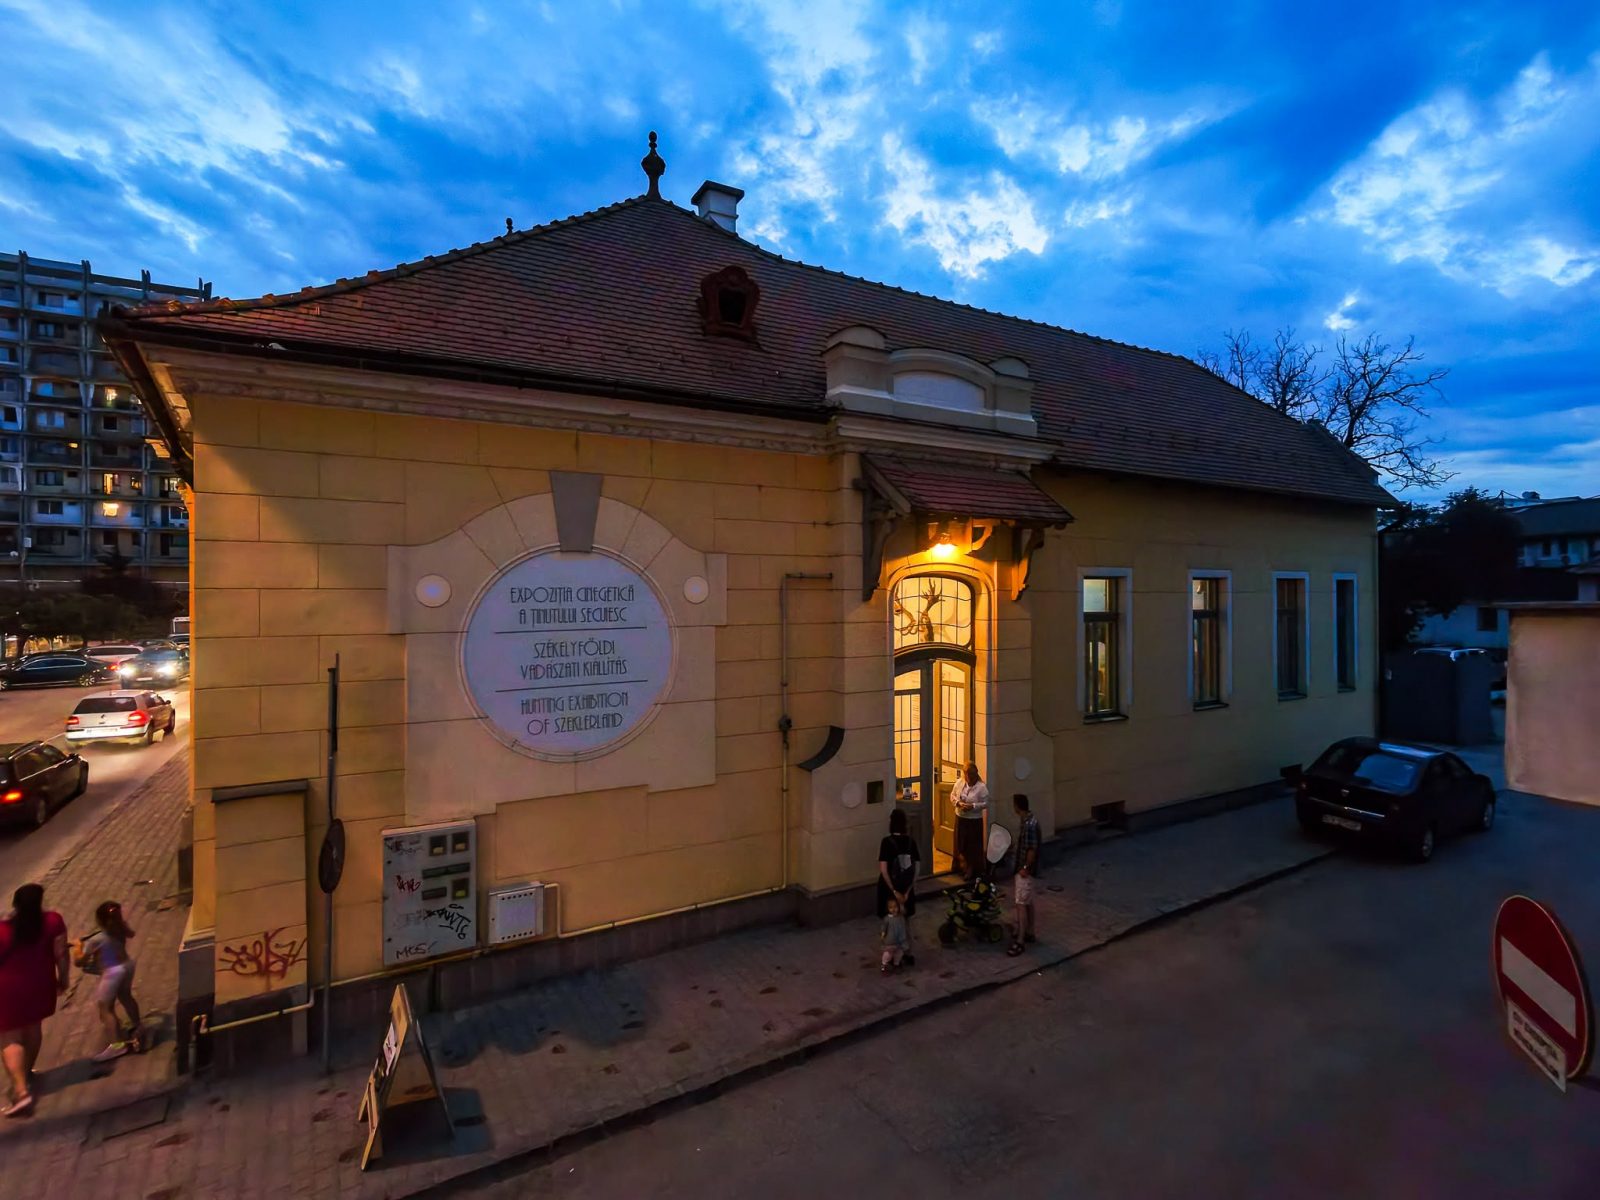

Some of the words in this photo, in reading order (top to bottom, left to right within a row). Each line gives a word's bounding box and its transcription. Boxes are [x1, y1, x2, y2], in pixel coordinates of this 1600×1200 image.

[519, 608, 527, 625] A
[580, 606, 628, 623] SECUIESC
[533, 637, 615, 659] SZÉKELYFÖLDI
[520, 660, 580, 681] VADÁSZATI
[583, 656, 628, 677] KIÁLLÍTÁS
[520, 696, 565, 715] HUNTING
[568, 691, 629, 711] EXHIBITION
[527, 718, 550, 736] OF
[553, 712, 624, 734] SZEKLERLAND
